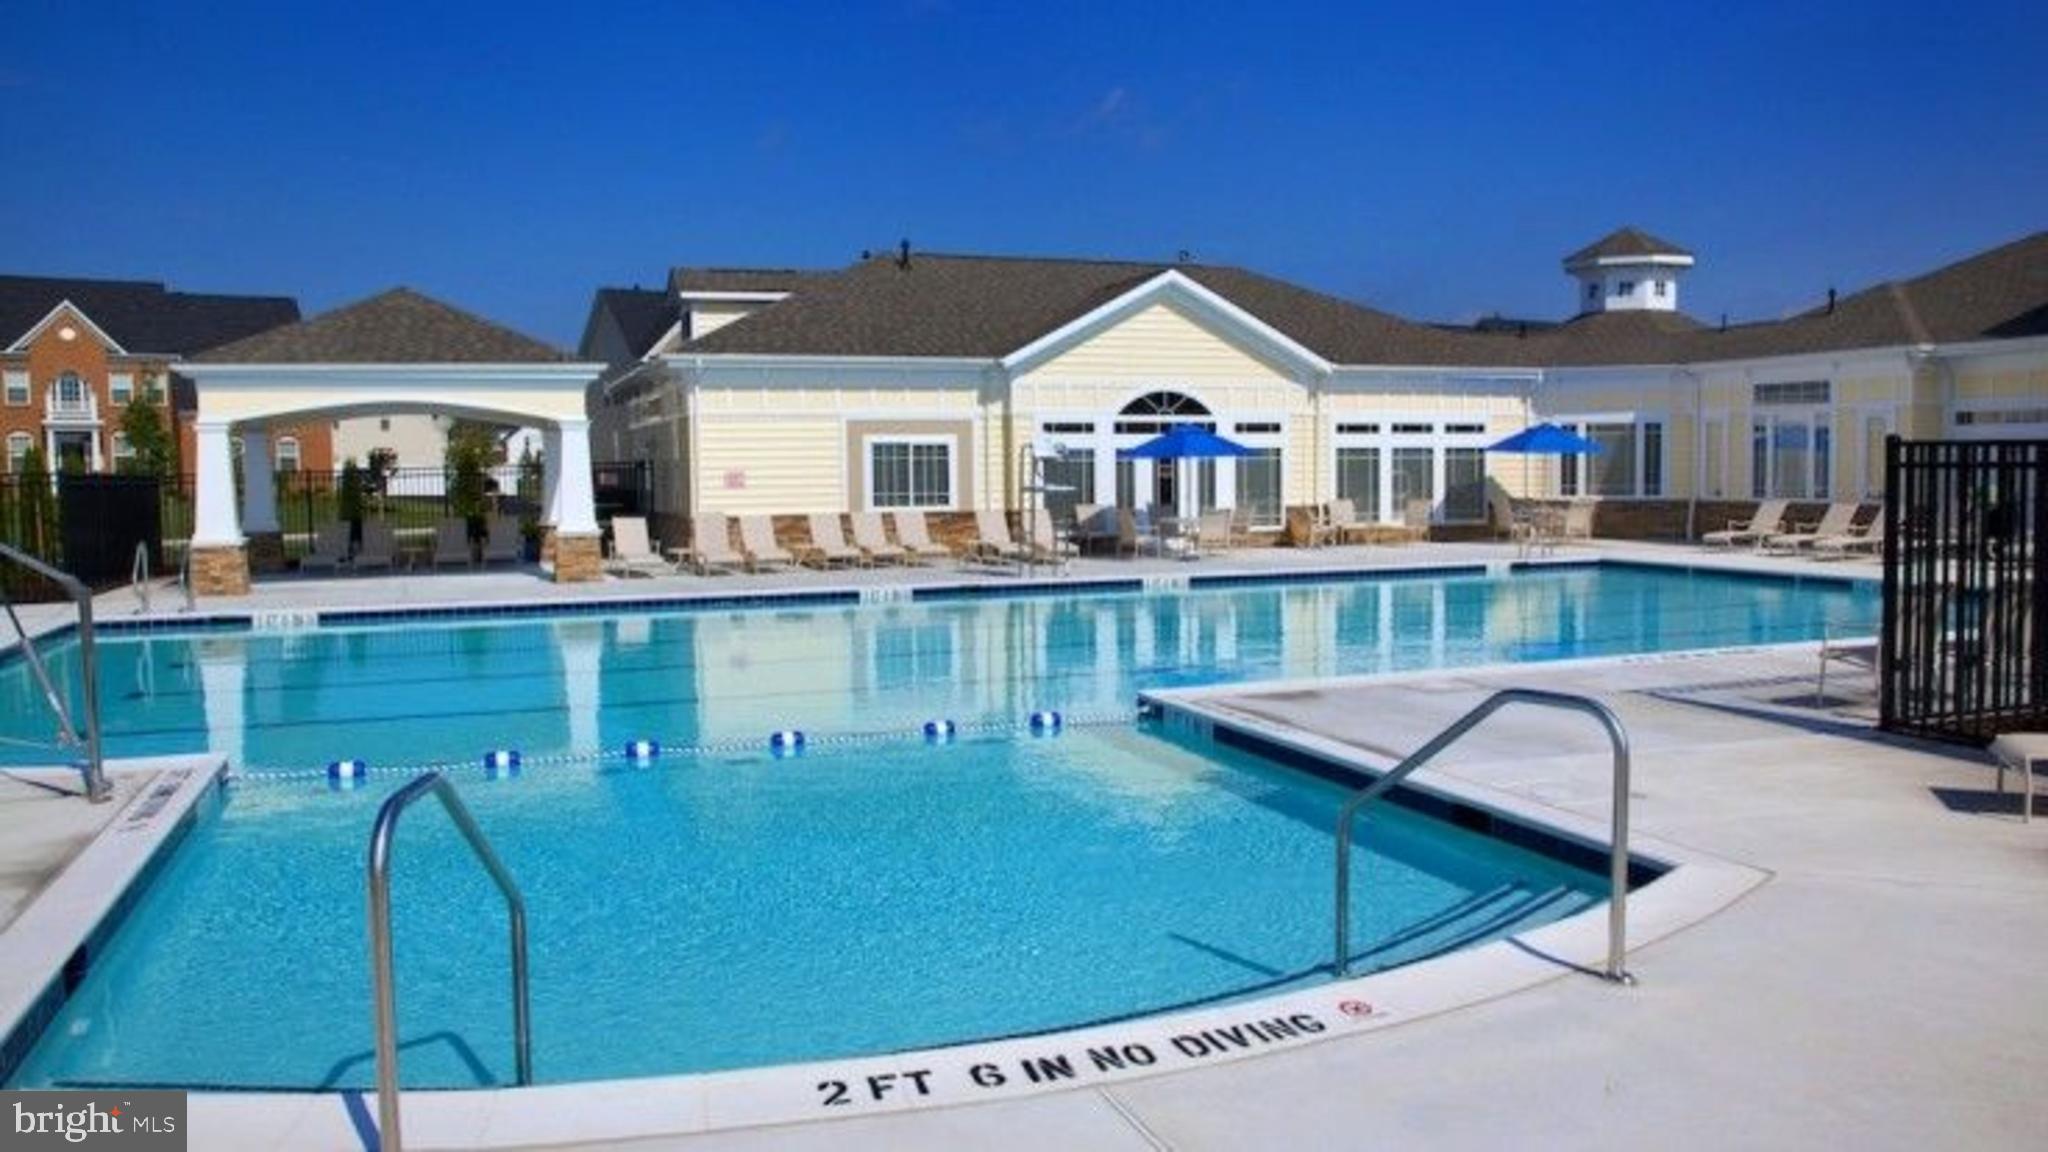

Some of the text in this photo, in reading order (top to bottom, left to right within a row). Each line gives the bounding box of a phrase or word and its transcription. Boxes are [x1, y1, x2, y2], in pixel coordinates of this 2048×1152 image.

[816, 1079, 853, 1107] 2
[867, 1069, 933, 1101] FT
[1020, 1054, 1075, 1083] IN
[1086, 1043, 1158, 1072] NO
[1171, 1013, 1327, 1058] DIVING
